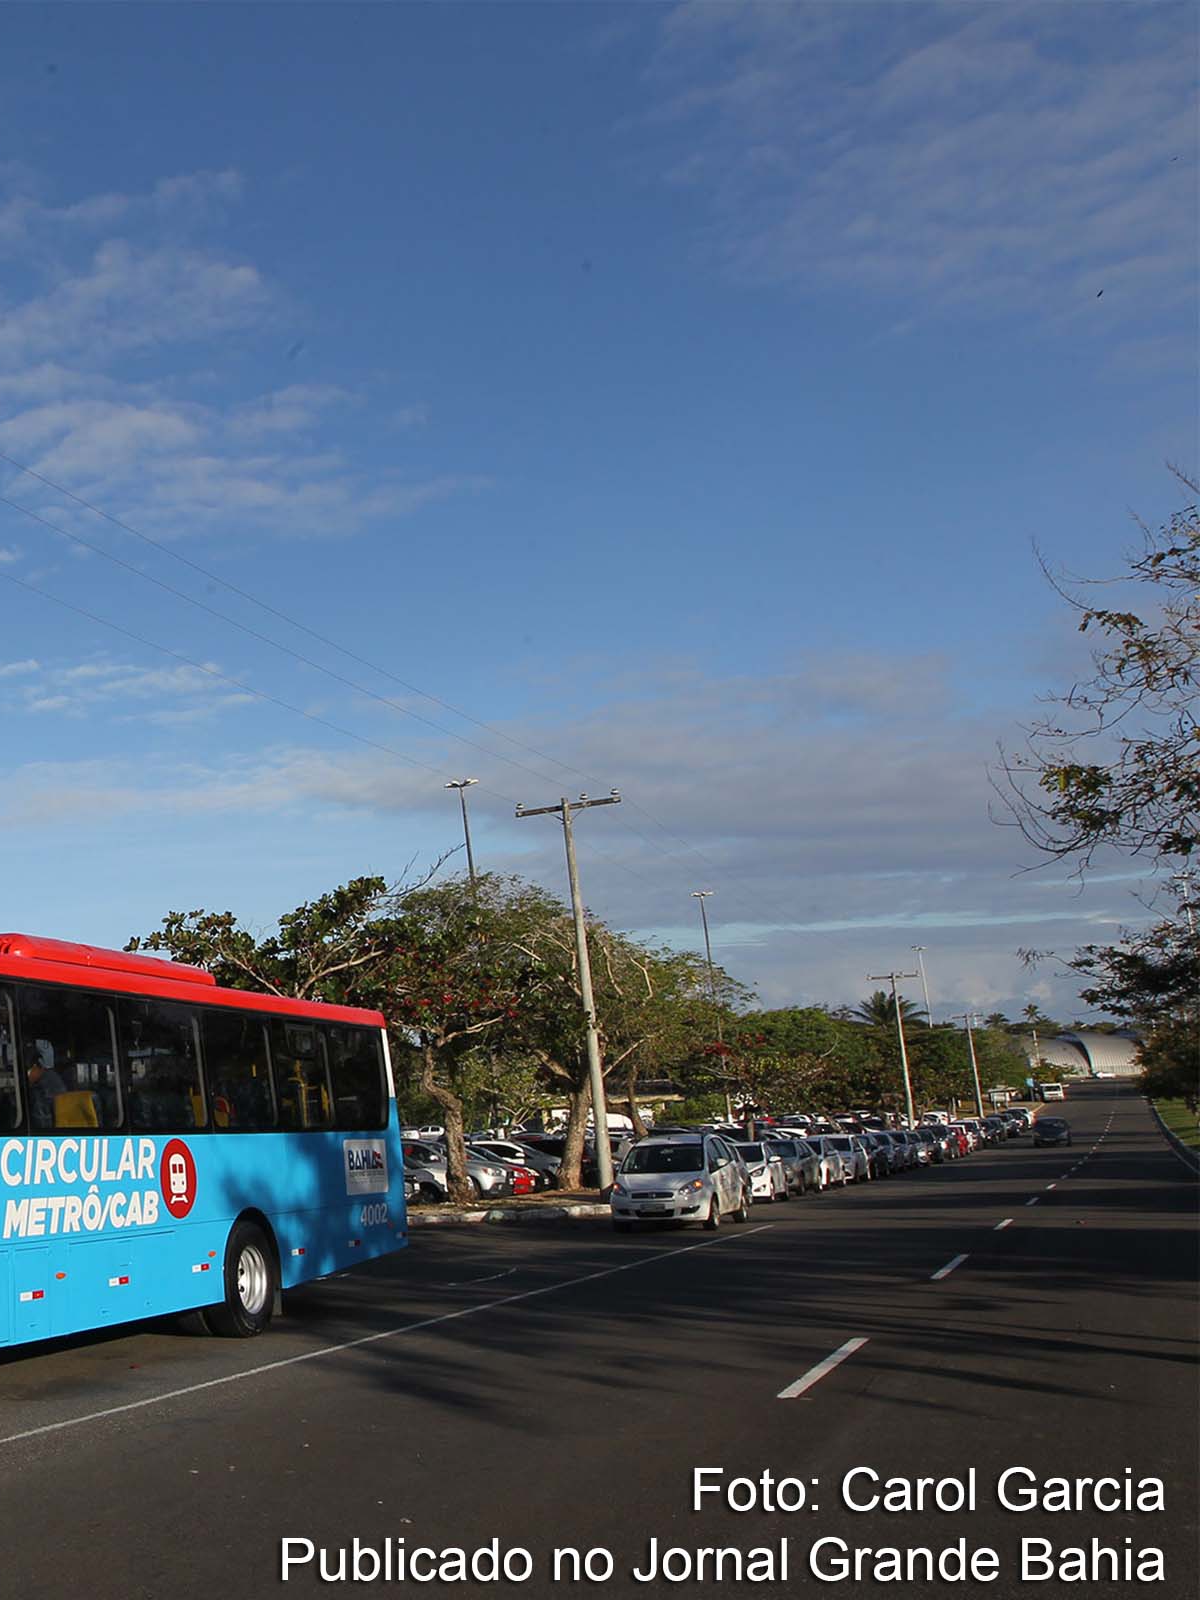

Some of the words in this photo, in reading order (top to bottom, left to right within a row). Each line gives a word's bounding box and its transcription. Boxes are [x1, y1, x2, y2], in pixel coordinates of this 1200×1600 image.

[0, 1138, 156, 1186] CIRCULAR
[347, 1149, 377, 1170] BAHIA
[3, 1184, 160, 1239] METRÔ/CAB
[360, 1203, 388, 1226] 4002
